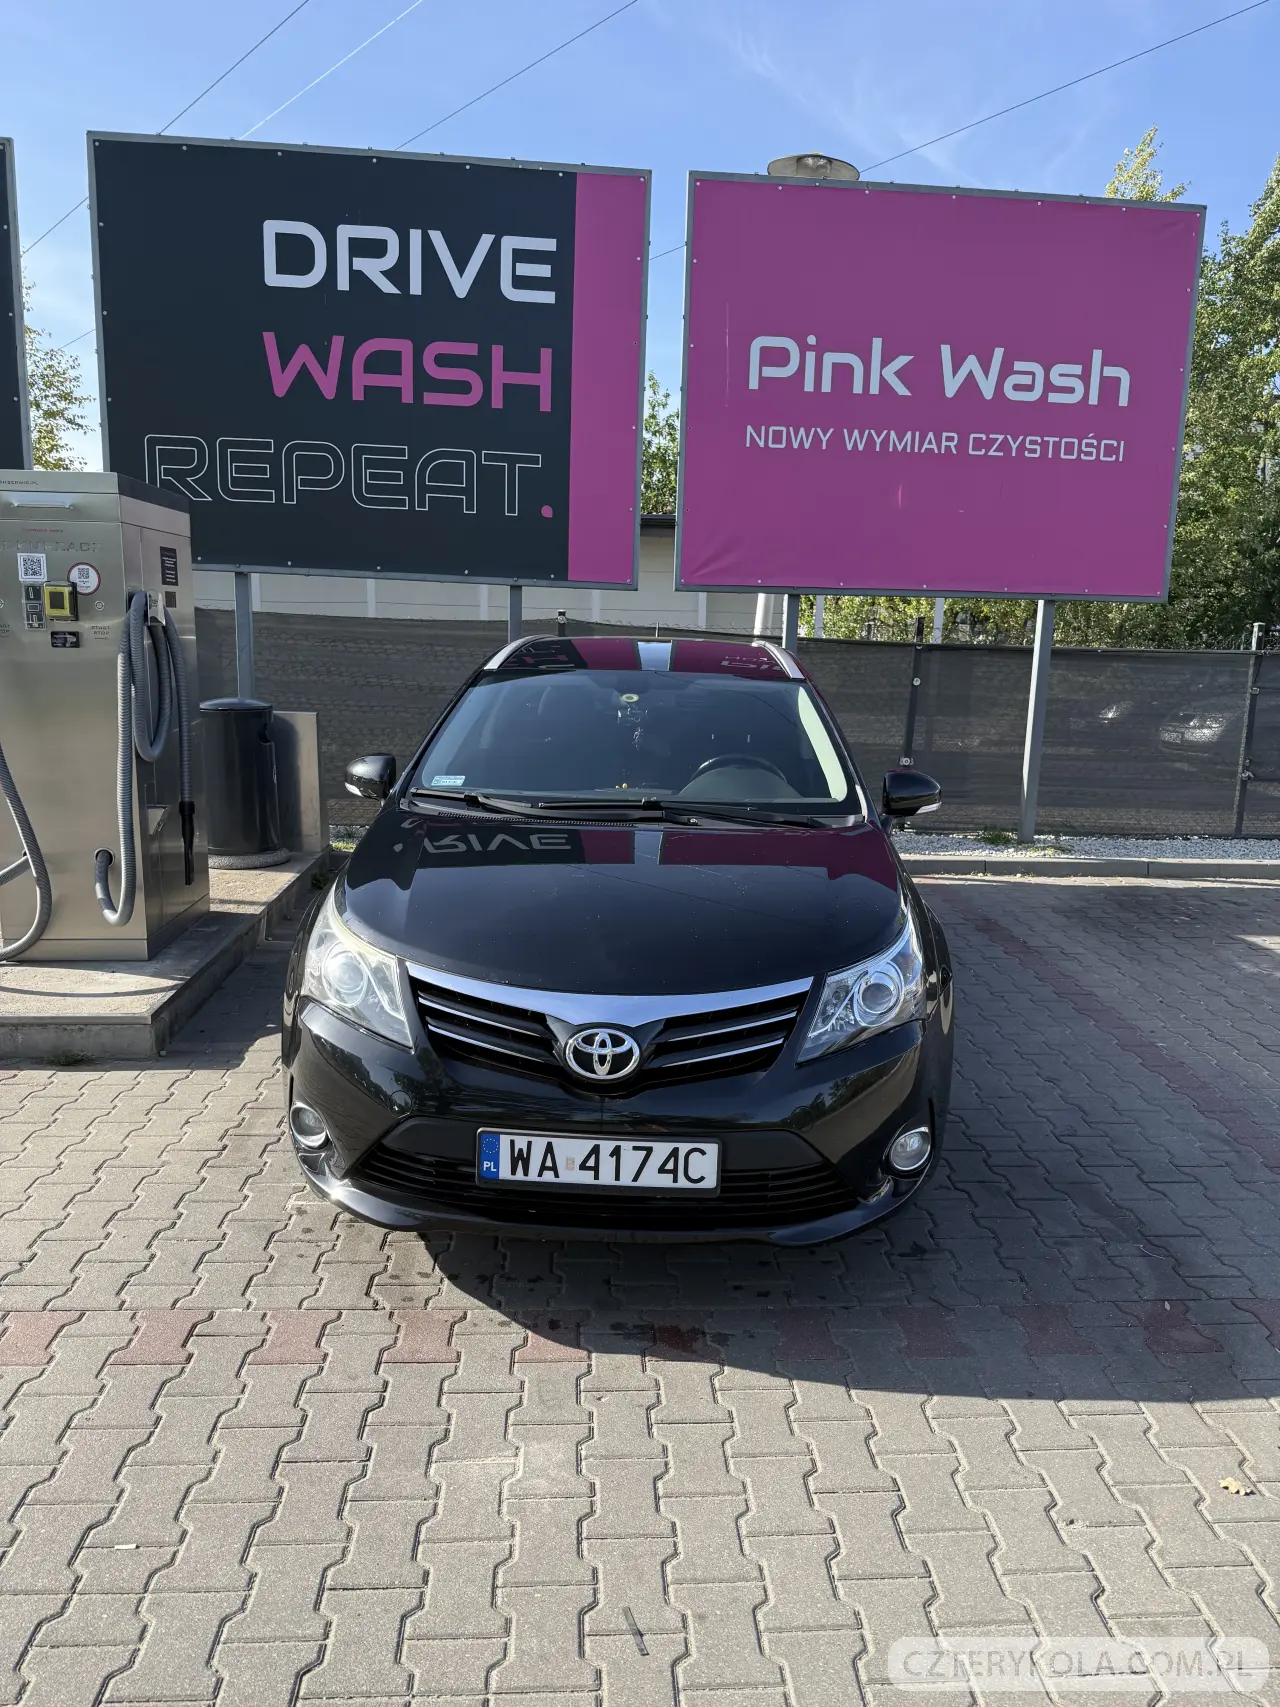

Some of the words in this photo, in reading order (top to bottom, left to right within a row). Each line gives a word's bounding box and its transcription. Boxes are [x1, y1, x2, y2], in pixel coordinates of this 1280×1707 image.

[262, 219, 557, 304] DRIVE
[262, 331, 553, 412] WASH
[748, 335, 915, 397] Pink
[940, 344, 1131, 407] Wash
[144, 434, 554, 519] REPEAT.
[745, 425, 834, 450] NOWY
[843, 428, 958, 455] WYMIAR
[968, 433, 1125, 462] CZYSTOŚCI
[483, 1161, 497, 1172] PL
[510, 1139, 560, 1178] WA
[578, 1143, 707, 1185] 4174C
